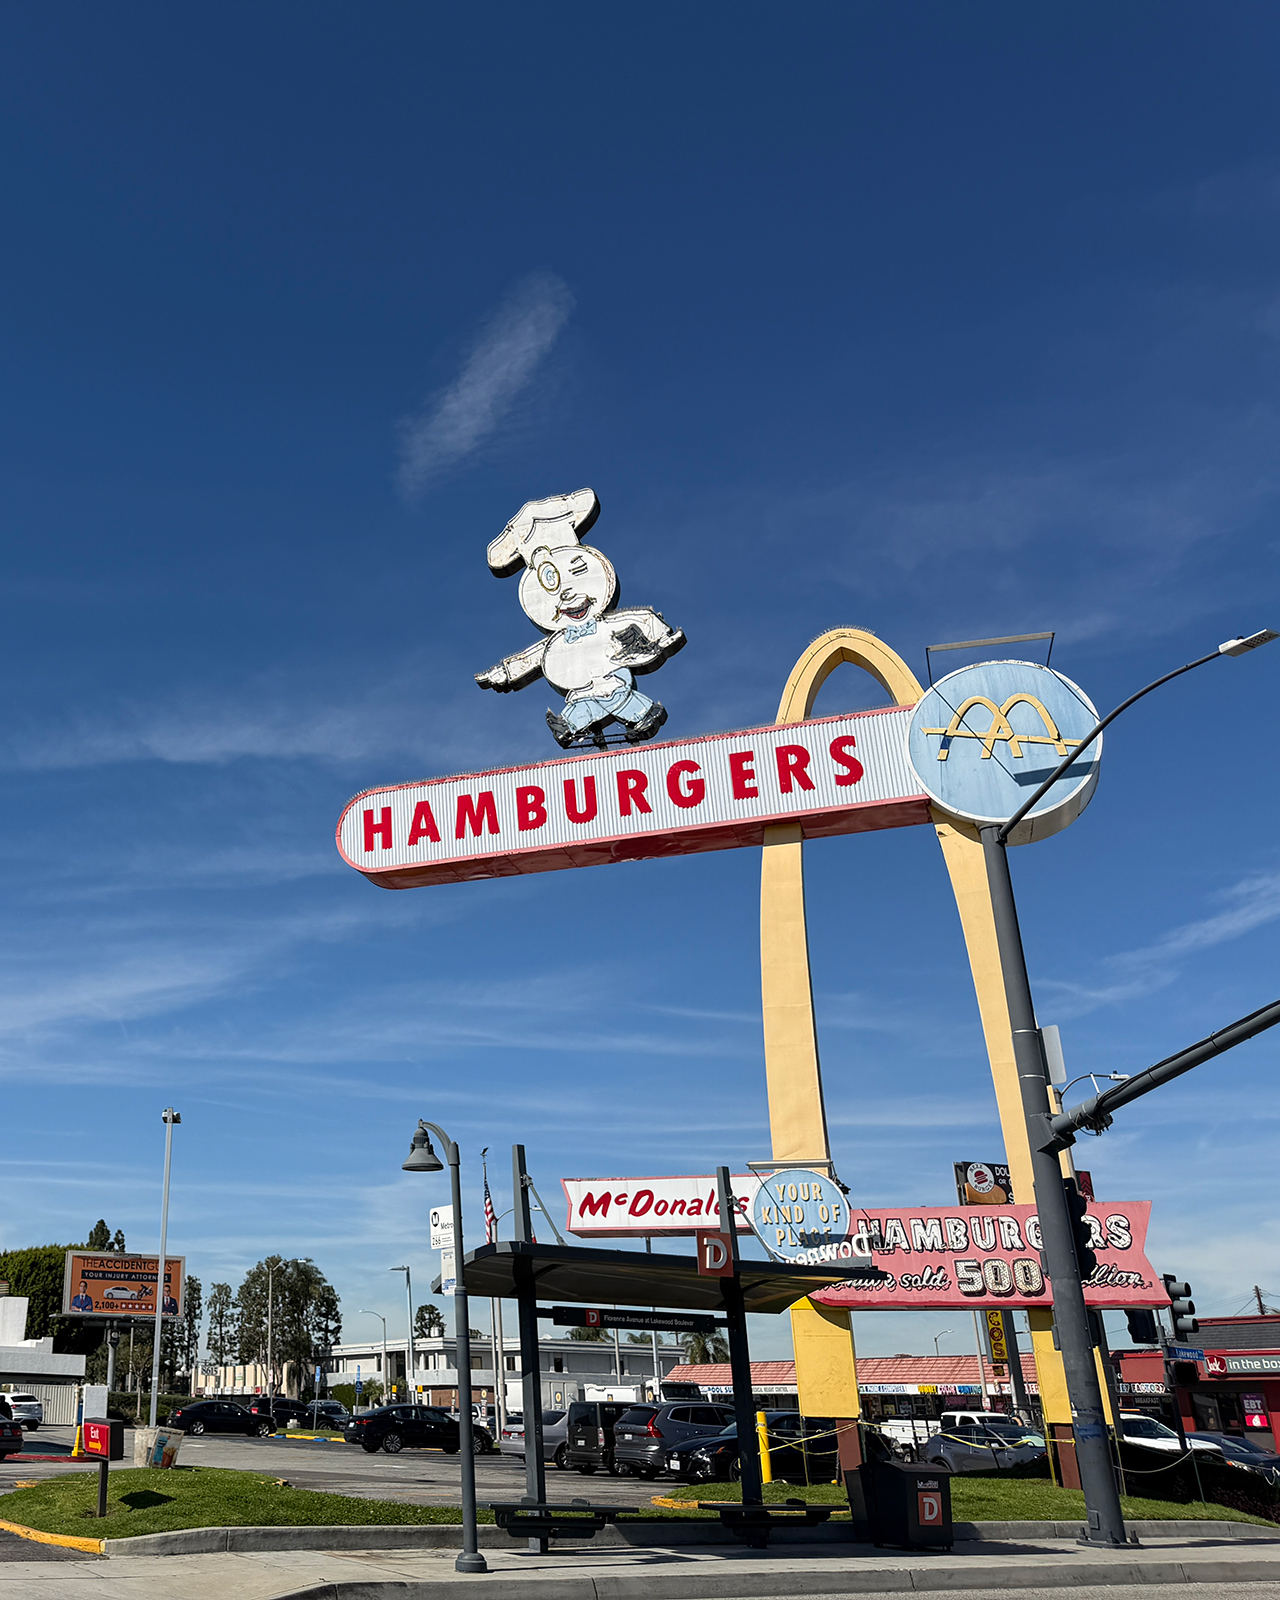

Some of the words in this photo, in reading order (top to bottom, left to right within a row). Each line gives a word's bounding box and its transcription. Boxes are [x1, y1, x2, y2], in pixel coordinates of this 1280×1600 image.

[363, 734, 866, 852] HAMBURGERS
[775, 1183, 823, 1202] YOUR
[761, 1205, 804, 1225] KIND
[819, 1204, 841, 1223] OF
[441, 1222, 454, 1230] Metro
[775, 1227, 832, 1247] PLACE
[857, 1213, 1132, 1253] HAMBURGRS
[432, 1237, 441, 1246] 266
[704, 1237, 727, 1269] D
[954, 1257, 1045, 1298] 500
[95, 1301, 119, 1310] 2,100+
[589, 1312, 598, 1323] D
[650, 1317, 674, 1325] Lakewood
[1175, 1349, 1199, 1359] Lakewood
[1229, 1359, 1240, 1369] in
[1241, 1358, 1261, 1369] the
[201, 1365, 218, 1376] 8615
[1131, 1383, 1165, 1393] FACTORY
[1244, 1399, 1261, 1409] EBT
[90, 1426, 99, 1439] Exit
[923, 1497, 938, 1520] D
